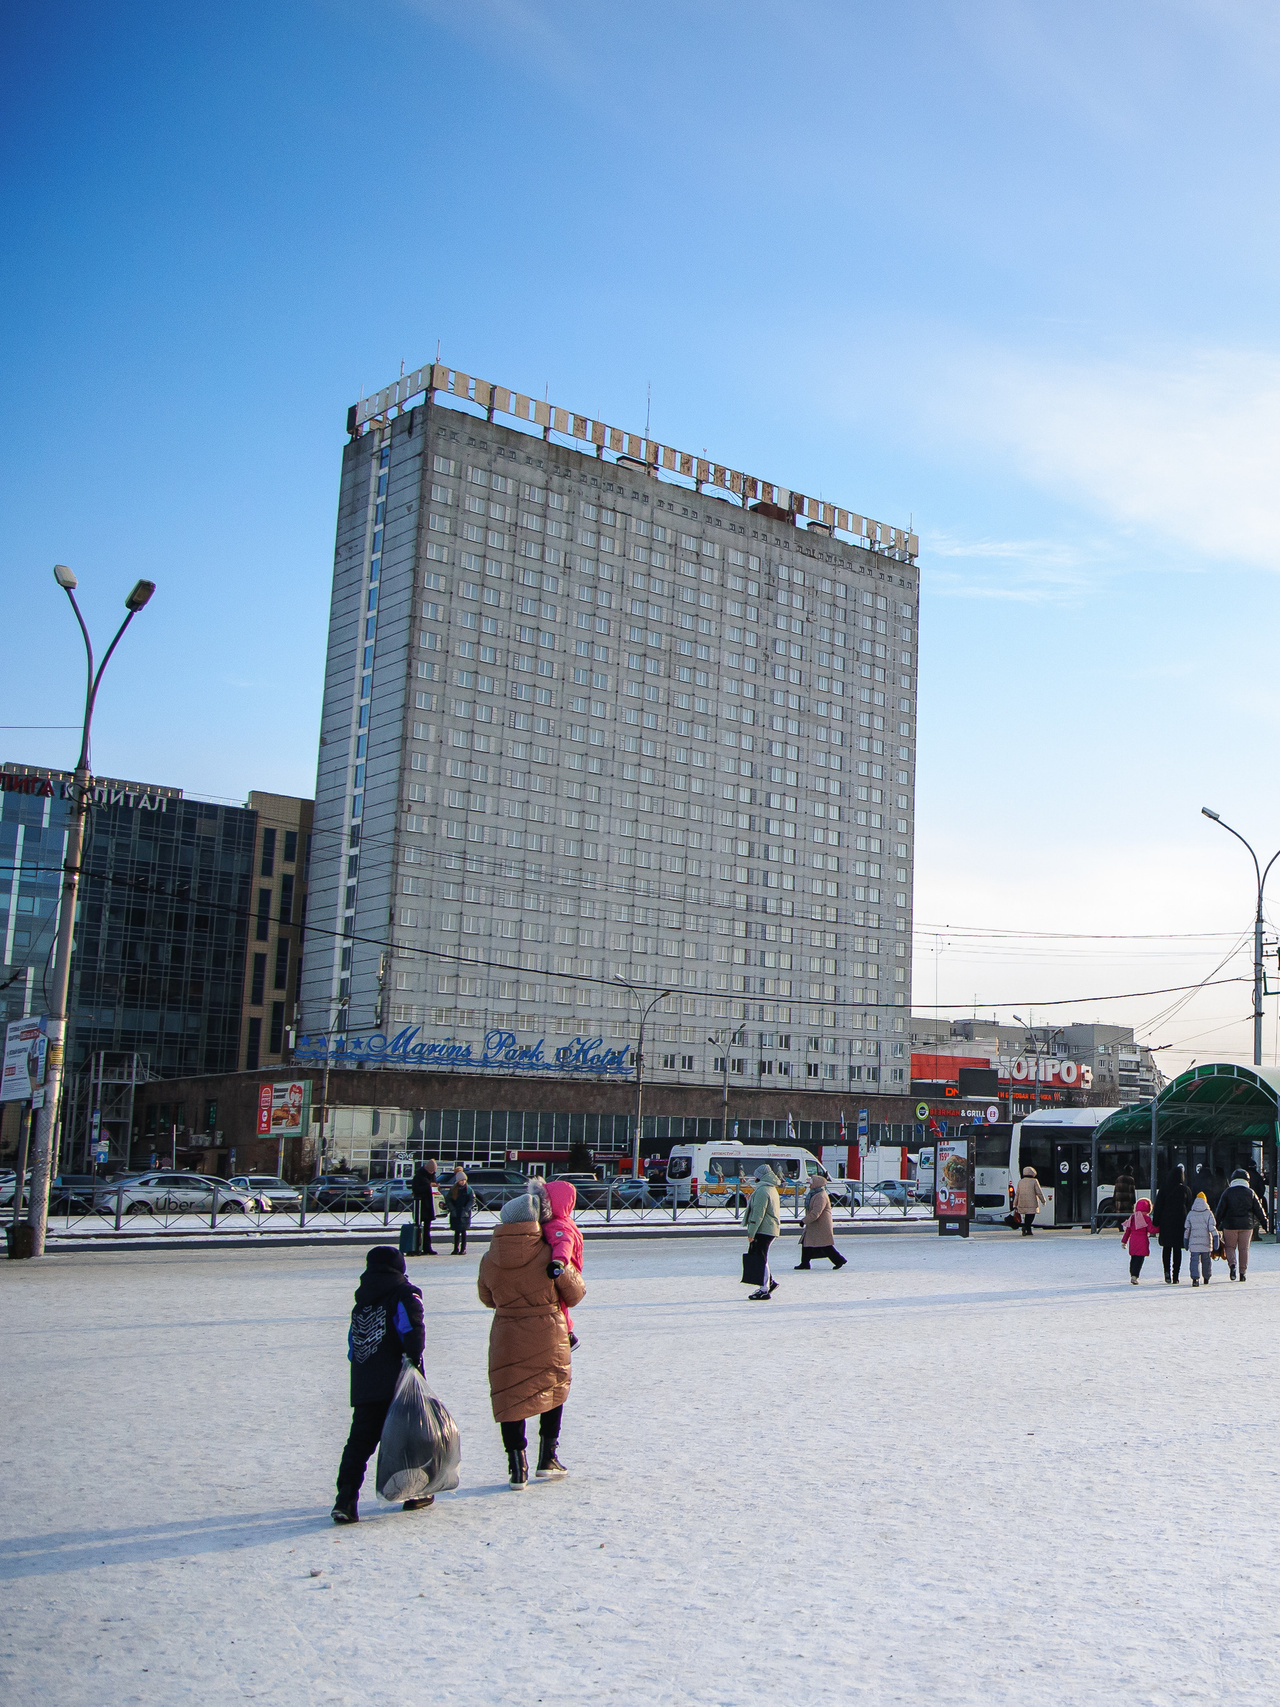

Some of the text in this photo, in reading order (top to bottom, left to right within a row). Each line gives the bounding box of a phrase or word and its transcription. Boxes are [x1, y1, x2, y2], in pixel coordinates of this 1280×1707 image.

[64, 782, 168, 813] КПИТАЛ
[367, 1025, 631, 1067] Marins Park Hotel
[960, 1109, 966, 1117] &
[966, 1110, 986, 1118] GRILL
[155, 1197, 196, 1211] Uber
